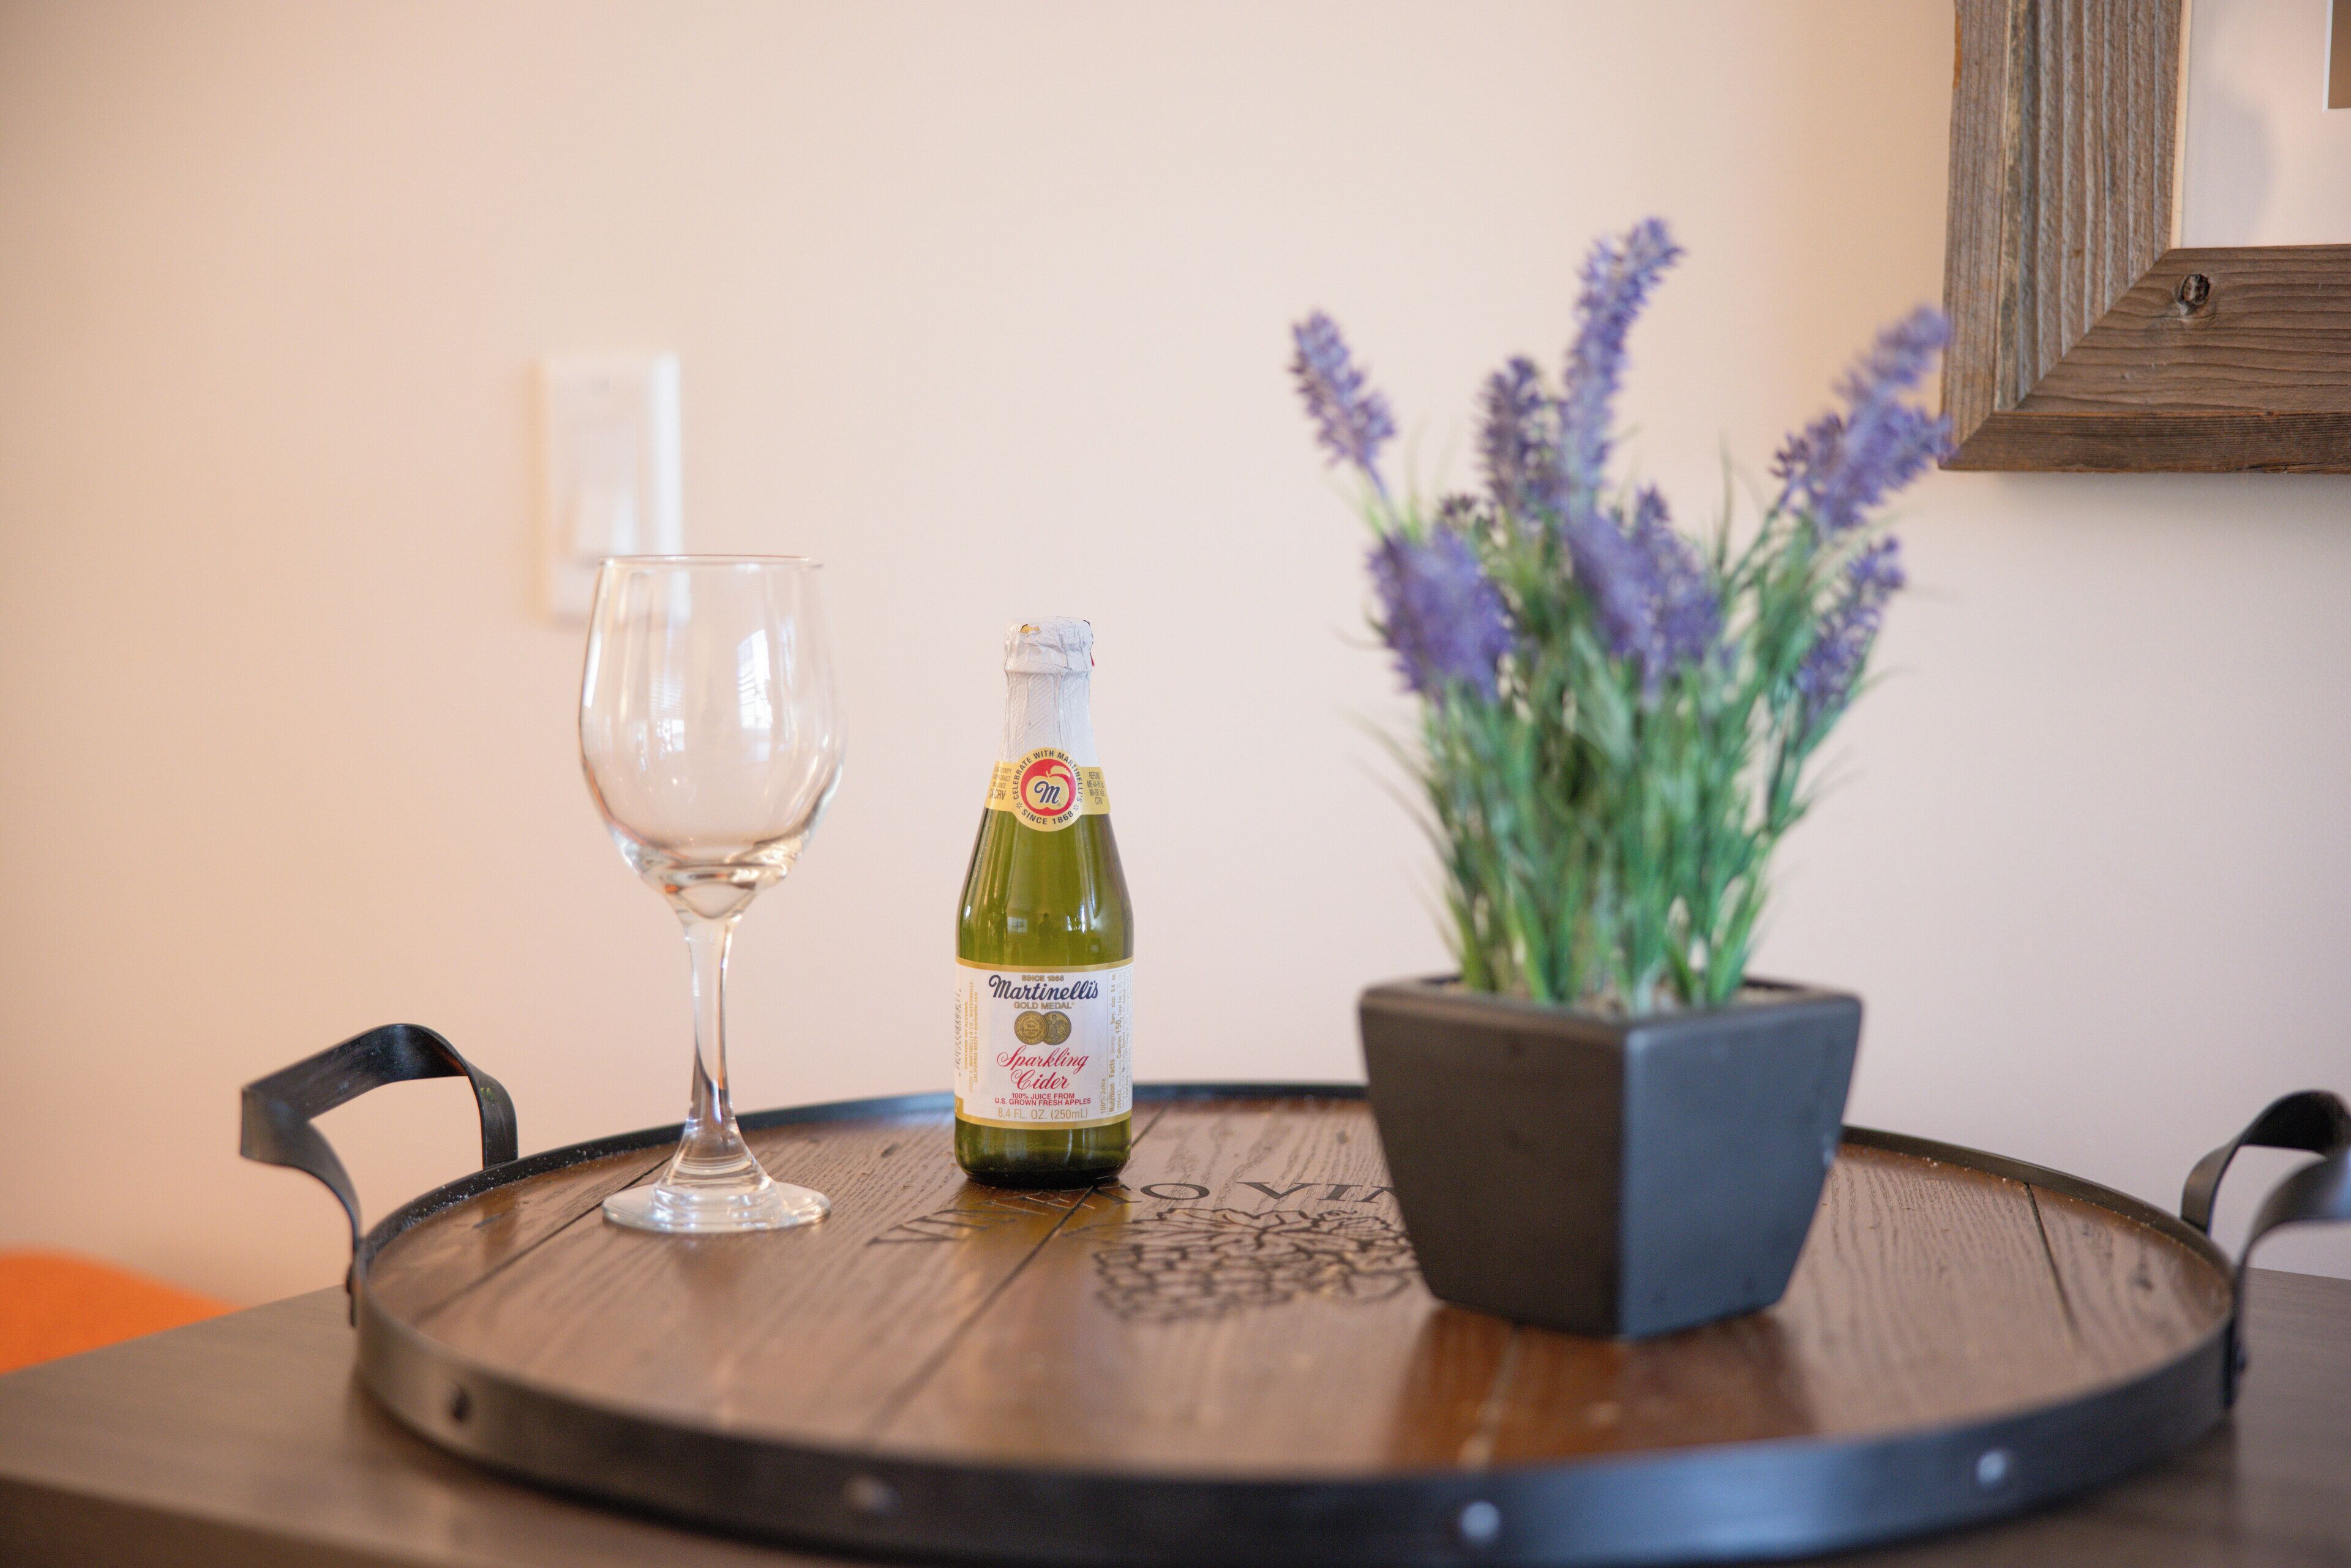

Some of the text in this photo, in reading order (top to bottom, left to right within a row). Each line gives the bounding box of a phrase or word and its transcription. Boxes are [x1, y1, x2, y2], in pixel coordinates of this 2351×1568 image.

[1013, 750, 1084, 803] CELEBRATE WITH MARTINELLI'S
[1022, 808, 1074, 825] SINCE 1868
[988, 974, 1098, 1000] Martinelli's
[964, 1029, 968, 1038] NO
[997, 1045, 1090, 1074] Sparkling
[1010, 1069, 1070, 1090] Cider
[997, 1108, 1089, 1120] 8.4 FL. OZ. (250mL)
